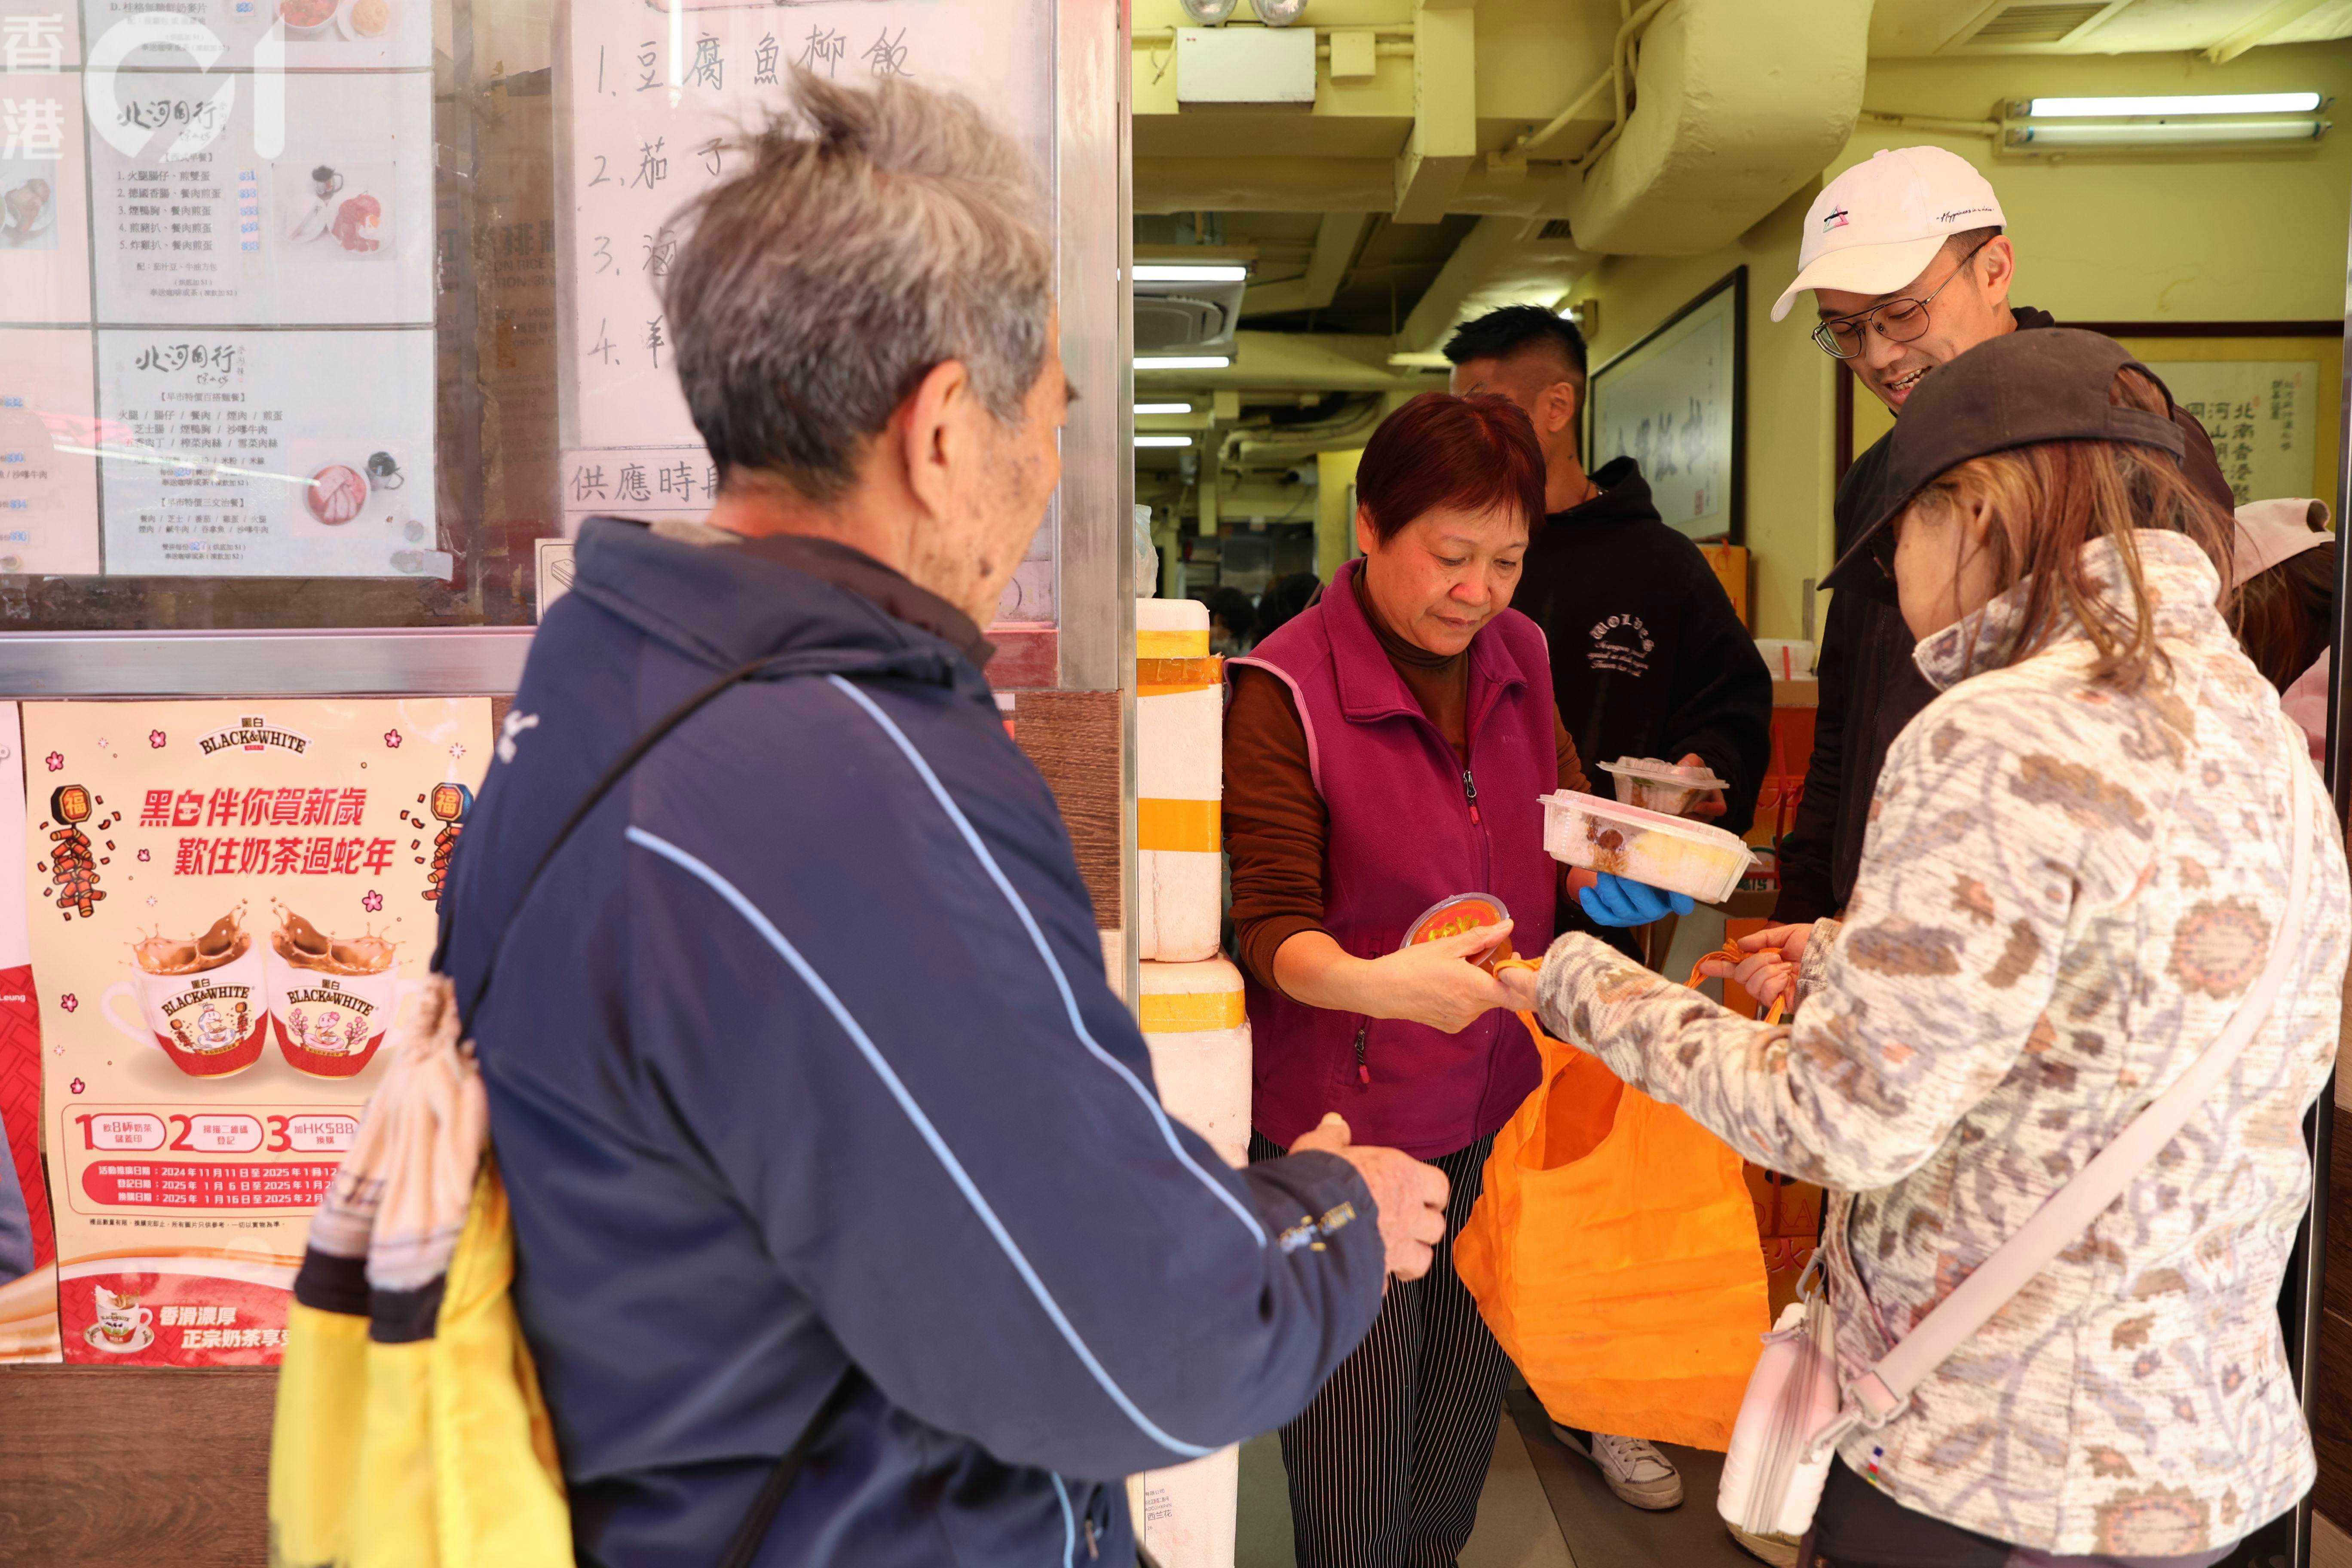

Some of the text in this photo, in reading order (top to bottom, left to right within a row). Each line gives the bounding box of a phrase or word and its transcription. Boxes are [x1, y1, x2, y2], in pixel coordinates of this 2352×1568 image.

[241, 717, 263, 728] 黑白
[199, 729, 306, 755] BLACK&WHITE
[66, 791, 87, 815] 福
[139, 787, 367, 827] 黑白伴你賀新歲
[435, 790, 456, 814] 福
[191, 978, 210, 989] 黑白
[322, 979, 340, 990] 黑白
[161, 986, 251, 1017] BLACK&WHITE
[287, 989, 374, 1017] BLACK&WHITE
[169, 1114, 193, 1151] 2
[217, 1136, 235, 1145] 登記
[266, 1115, 292, 1153] 3
[159, 1306, 237, 1326] 香滑濃厚
[1147, 1510, 1172, 1521] 西兰花
